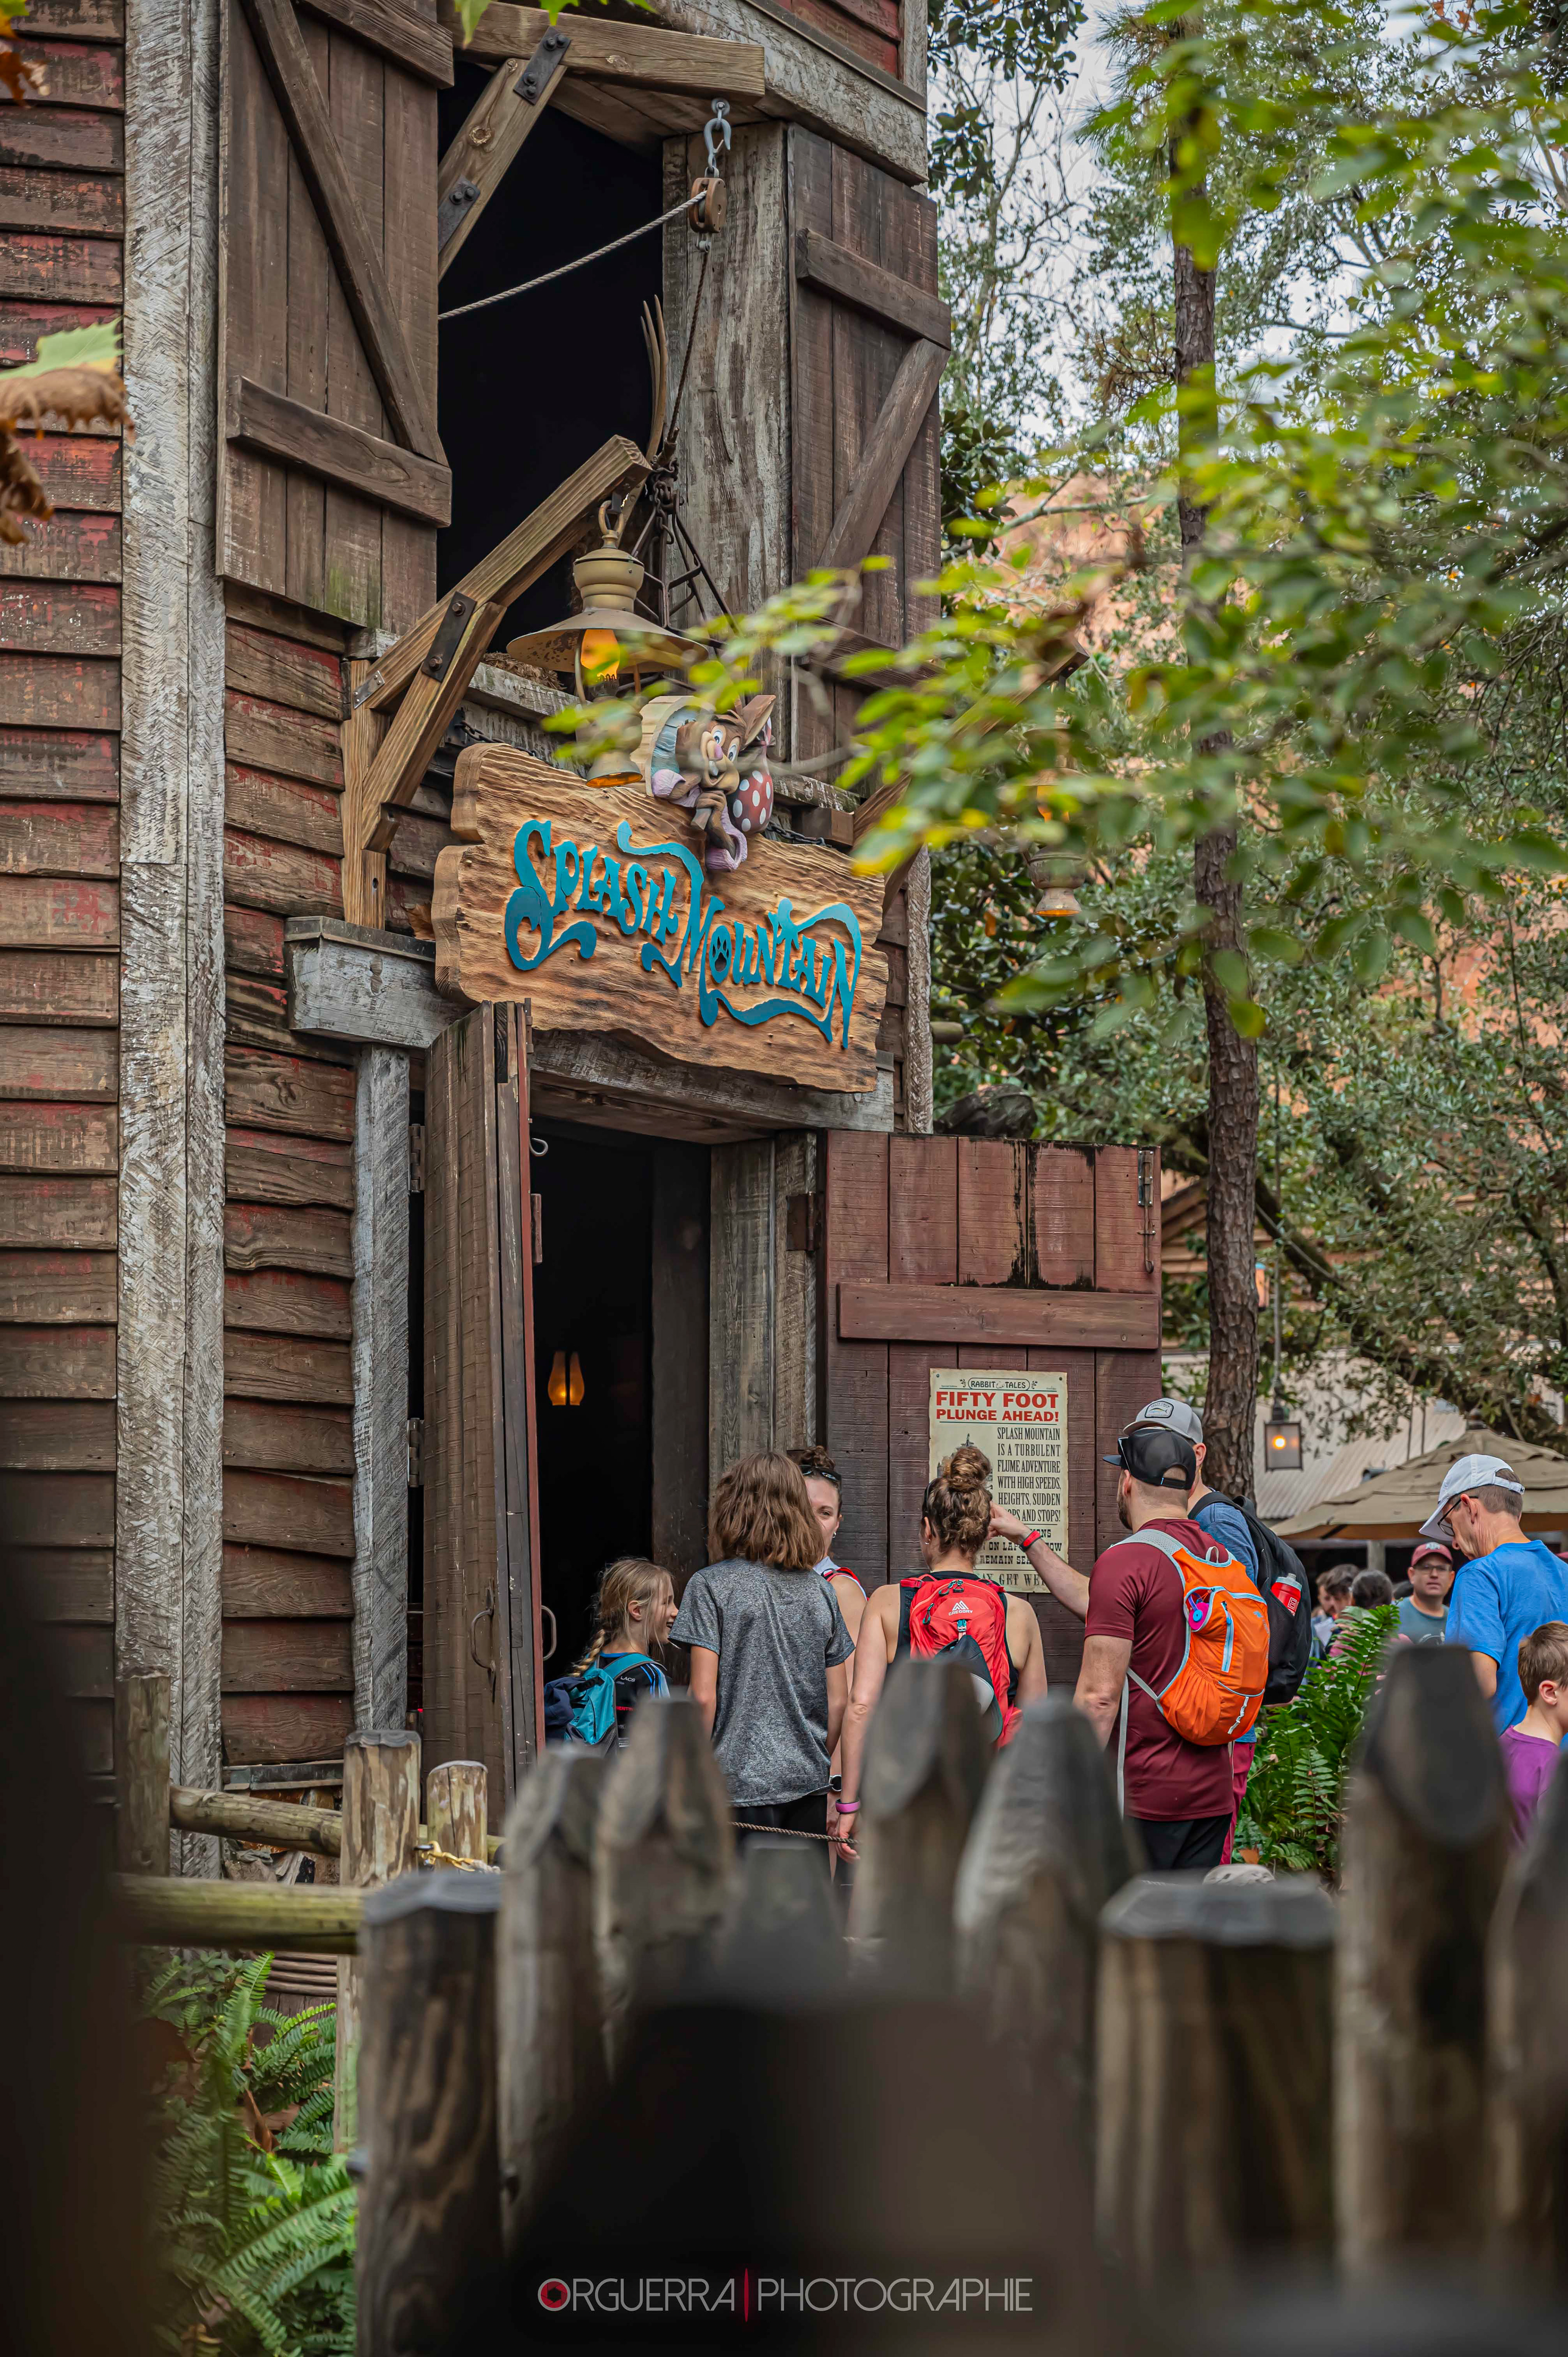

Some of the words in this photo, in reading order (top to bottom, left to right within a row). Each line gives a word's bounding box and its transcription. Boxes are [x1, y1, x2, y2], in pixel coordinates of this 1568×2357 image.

[936, 1391, 996, 1407] FIFTY
[1003, 1393, 1059, 1408] FOOT
[936, 1409, 997, 1421] PLUNGE
[1002, 1410, 1059, 1422] AHEAD!
[997, 1427, 1023, 1440] SPLASH
[1025, 1427, 1060, 1441] MOUNTAIN
[998, 1443, 1005, 1456] IS
[1007, 1443, 1012, 1456] A
[1014, 1443, 1061, 1457] TURBULENT
[997, 1459, 1020, 1472] FLUME
[1021, 1460, 1061, 1473] ADVENTURE
[997, 1476, 1016, 1489] WITH
[1017, 1476, 1034, 1489] HIGH
[1035, 1476, 1061, 1490] SPEEDS,
[998, 1492, 1031, 1506] HEIGHTS,
[1033, 1493, 1060, 1506] SUDDEN
[1021, 1509, 1036, 1521] AND
[1038, 1510, 1061, 1522] STOPS!
[989, 1542, 1000, 1551] ON
[980, 1555, 1013, 1565] REMAIN
[999, 1573, 1019, 1585] GET
